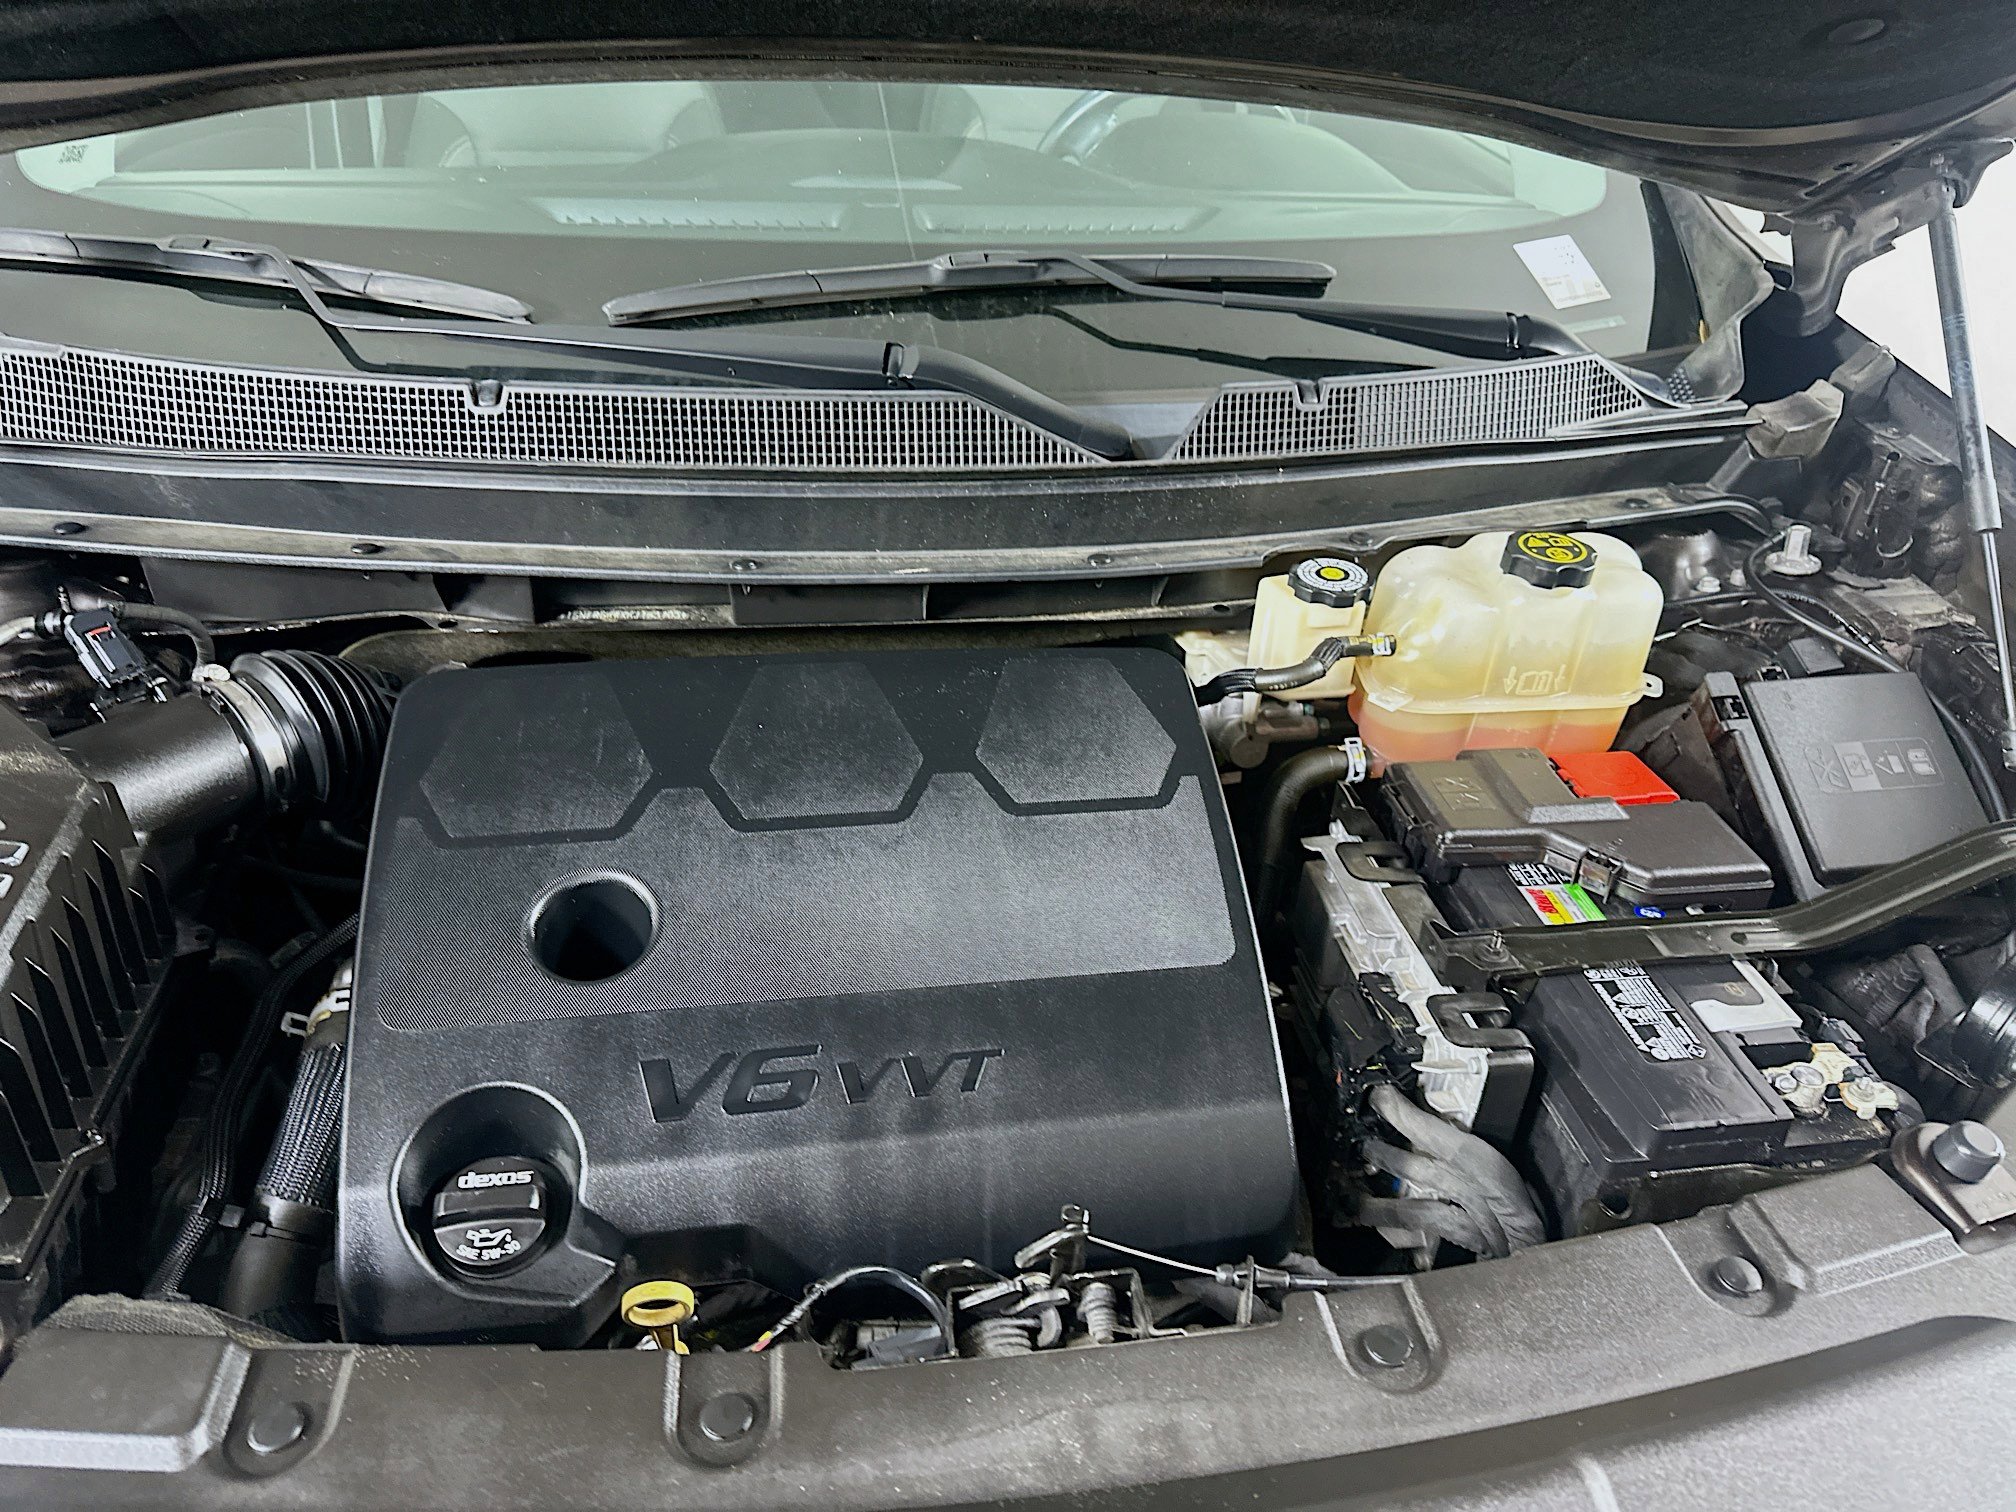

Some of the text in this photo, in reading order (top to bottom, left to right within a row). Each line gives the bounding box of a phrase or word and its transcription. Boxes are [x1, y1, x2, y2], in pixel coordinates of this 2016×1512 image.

[639, 1044, 1005, 1123] V6 VVT
[457, 1170, 534, 1189] dexos
[481, 1240, 521, 1260] 5W-30
